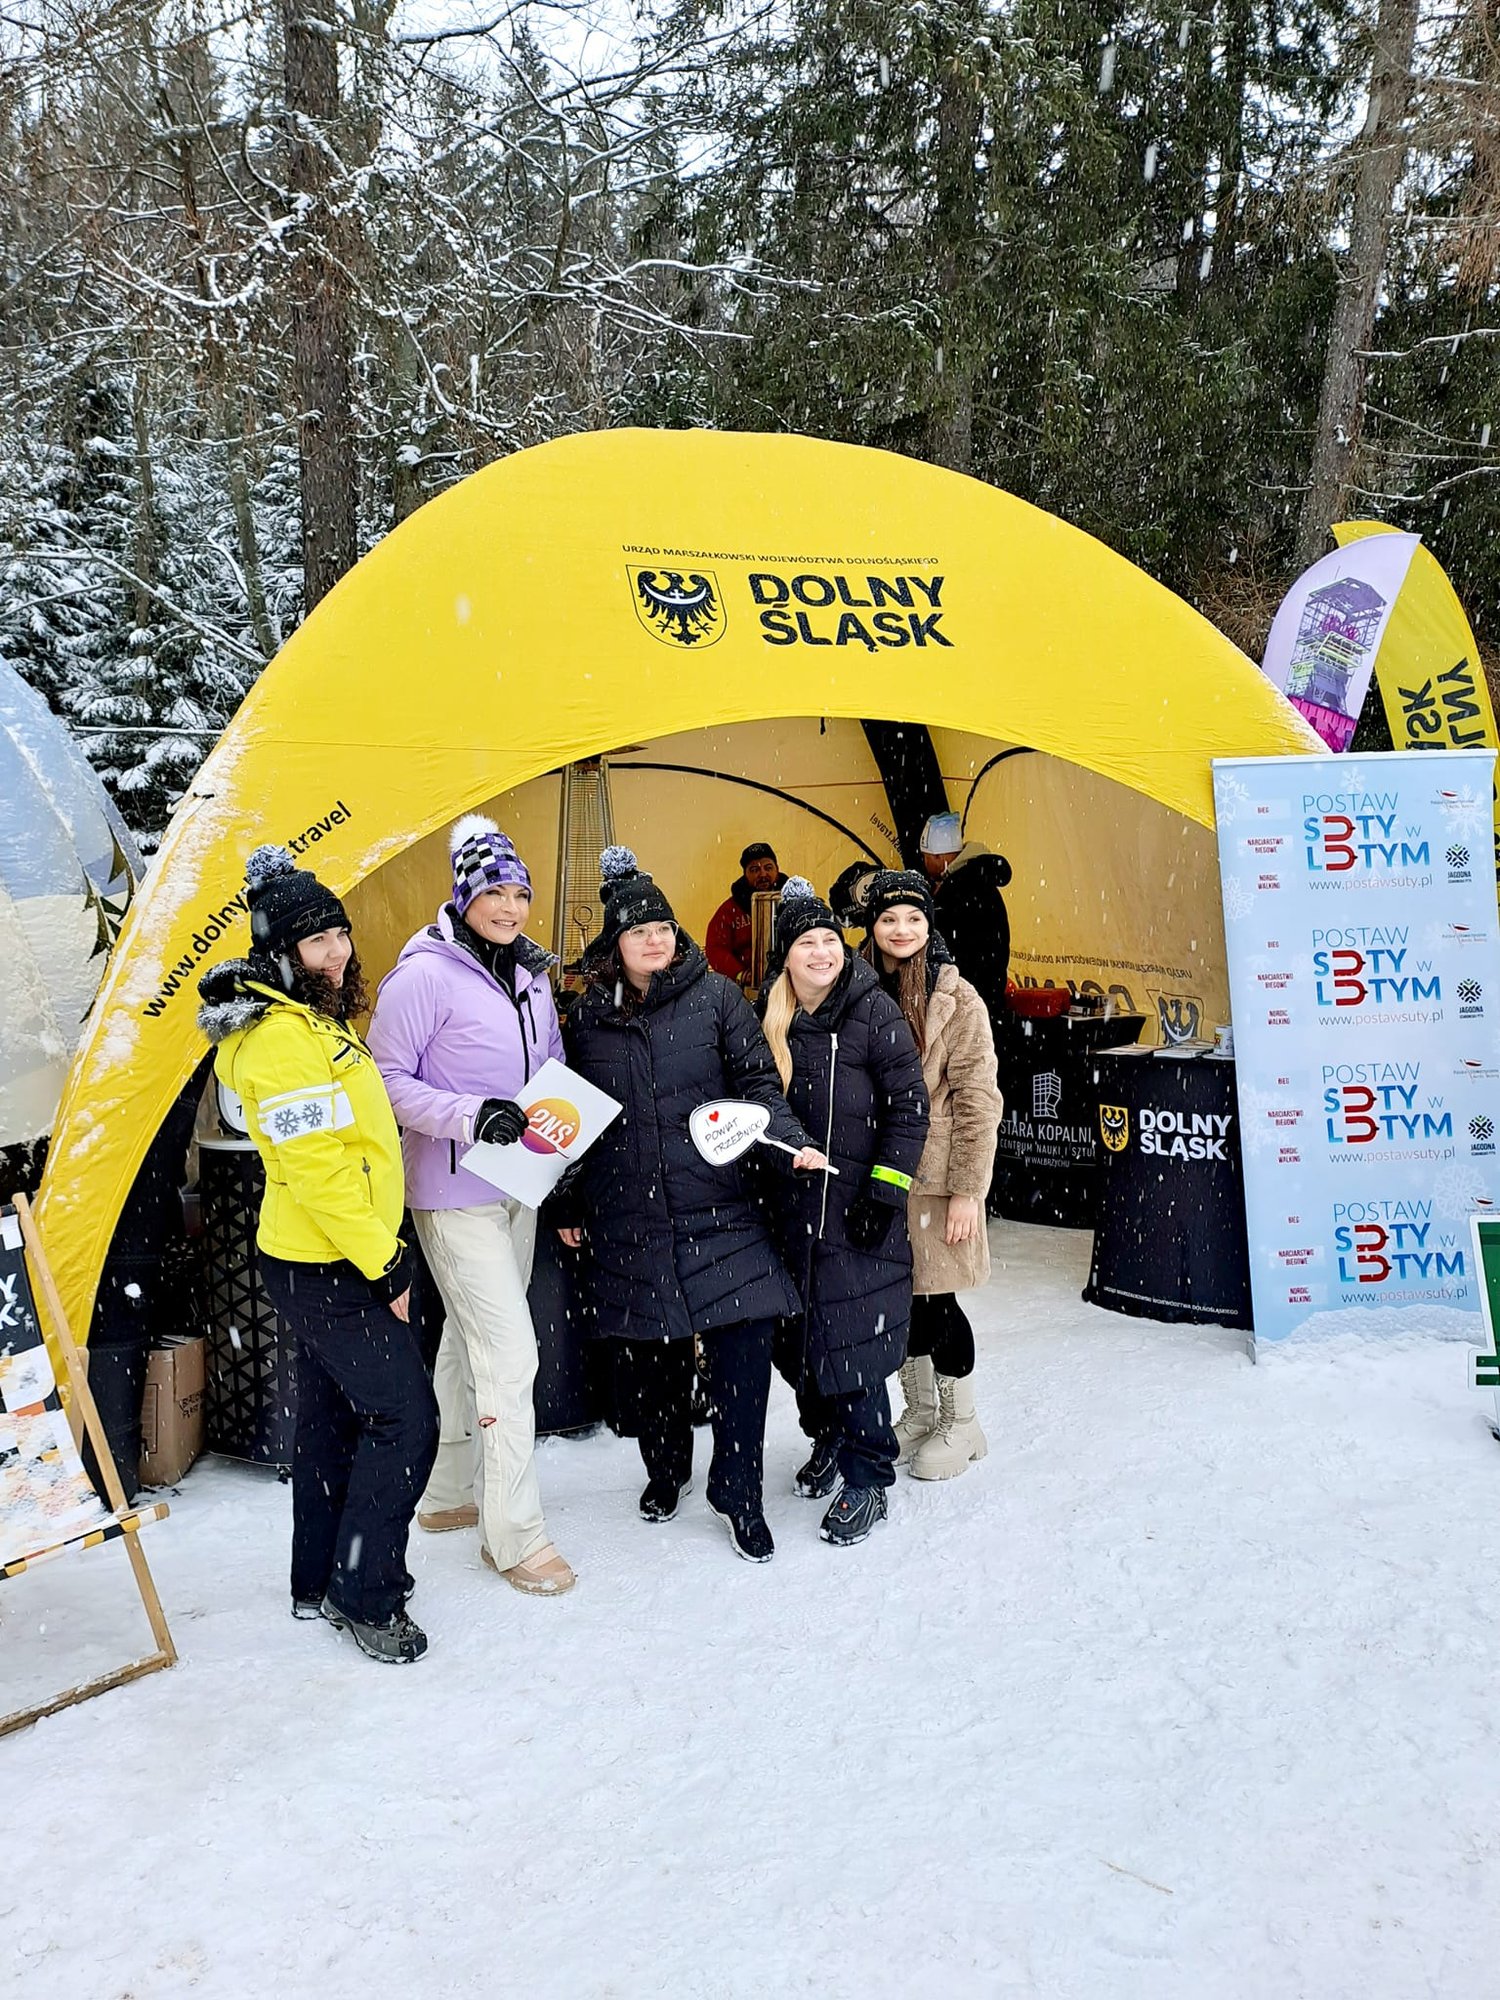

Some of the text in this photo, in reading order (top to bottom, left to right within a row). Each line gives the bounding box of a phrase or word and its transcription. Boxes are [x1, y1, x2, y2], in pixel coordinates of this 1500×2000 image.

[622, 544, 939, 567] URZĄD MARSZAŁKOWSKI WOJEWÓDZTWA DOLNOŚLĄSKIEGO
[748, 573, 946, 608] DOLNY
[762, 603, 955, 653] ŚLĄSK
[1303, 792, 1399, 813] POSTAW
[1309, 874, 1433, 891] www.postawsuty.pl
[1312, 926, 1409, 948] POSTAW
[1318, 1009, 1444, 1026] www.postawsuty.pl
[1322, 1062, 1420, 1084] POSTAW
[705, 1116, 738, 1143] POWIAT
[1000, 1119, 1092, 1143] STARA KOPALNI
[1139, 1109, 1232, 1136] DOLNY
[713, 1118, 764, 1156] TRZEBNICKI
[1000, 1138, 1033, 1152] CENTRUM
[1036, 1144, 1060, 1156] NAUKI
[1140, 1129, 1227, 1161] ŚLĄSK
[1329, 1147, 1455, 1163] www.postawsuty.pl
[1333, 1199, 1432, 1222] POSTAW
[1341, 1287, 1468, 1304] www.postawsuty.pl
